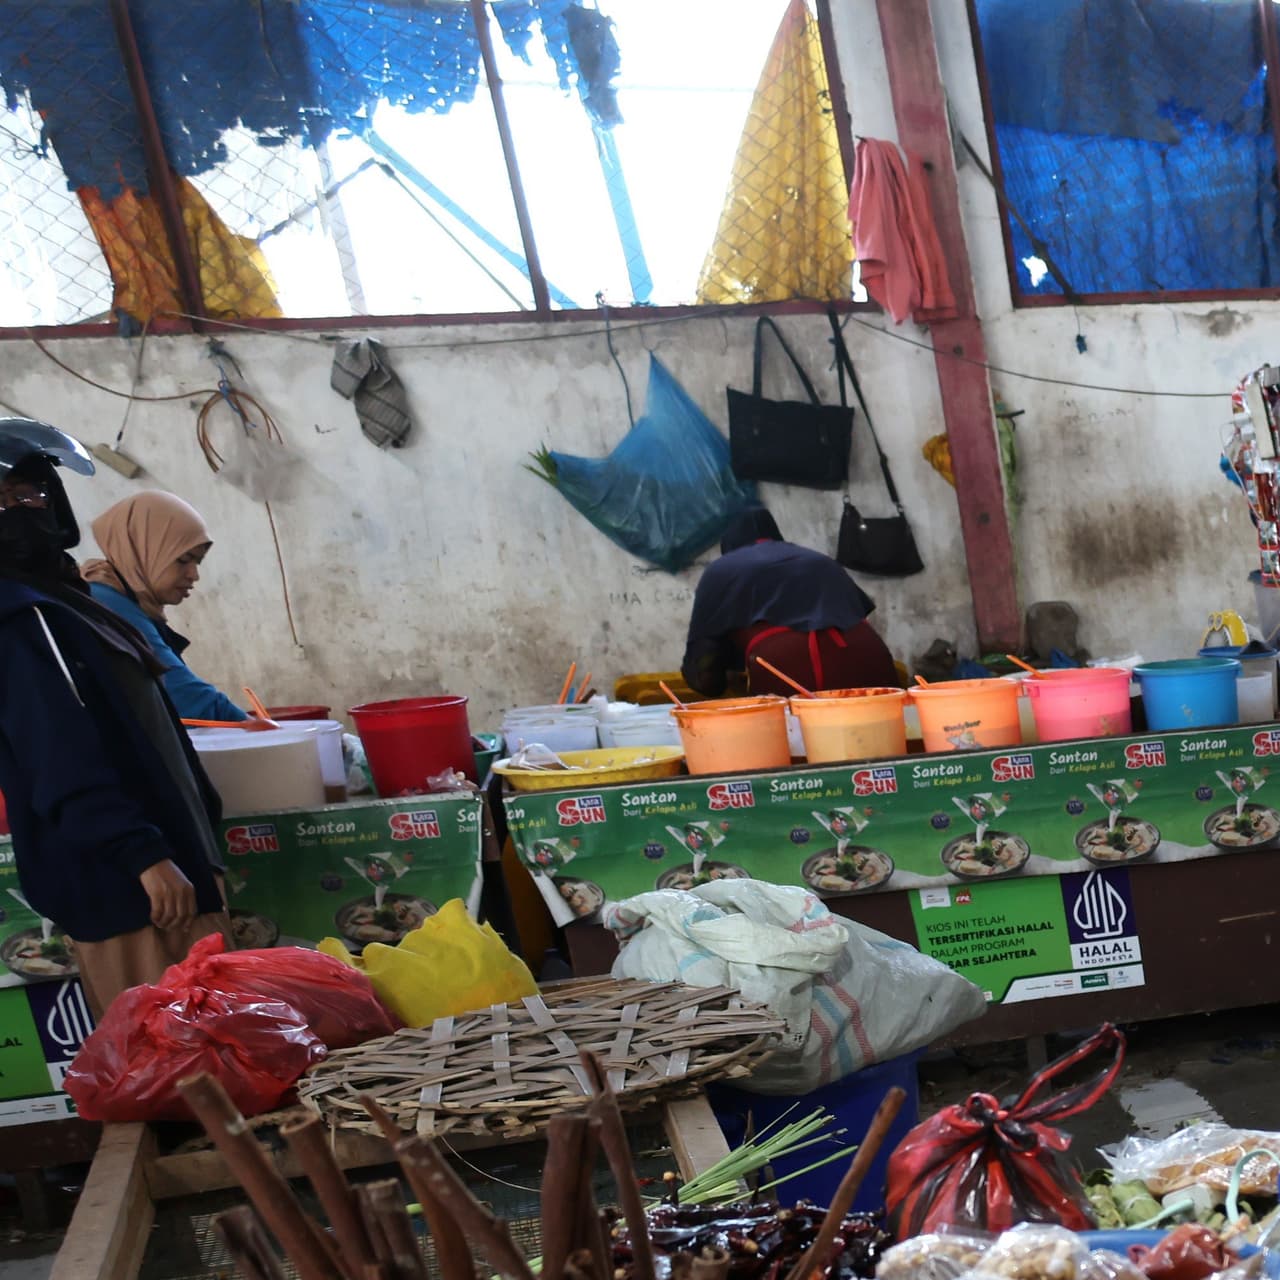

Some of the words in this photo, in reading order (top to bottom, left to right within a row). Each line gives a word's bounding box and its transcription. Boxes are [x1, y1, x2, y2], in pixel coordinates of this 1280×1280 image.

[1179, 738, 1227, 752] Santan
[1049, 750, 1098, 765] Santan
[1124, 744, 1166, 769] SUN
[912, 764, 964, 779] Santan
[991, 757, 1035, 782] SUN
[1050, 766, 1066, 775] Dari
[1068, 764, 1097, 774] Kelapa
[1100, 760, 1115, 769] Asli
[769, 778, 823, 793] Santan
[852, 770, 898, 796] SUN
[913, 779, 930, 788] Dari
[933, 777, 962, 787] Kelapa
[965, 774, 982, 783] Asli
[621, 791, 677, 807] Santan
[707, 785, 755, 811] SUN
[556, 799, 606, 826] SUN
[296, 821, 355, 836] Santan
[389, 814, 441, 840] SUN
[225, 825, 280, 855] SUN
[926, 921, 951, 933] KIOS
[954, 919, 969, 930] INI
[972, 915, 1006, 927] TELAH
[928, 926, 1015, 946] TERSERTIFIKASI
[1017, 921, 1054, 933] HALAL
[931, 945, 968, 959] DALAM
[971, 938, 1025, 954] PROGRAM
[1079, 941, 1132, 958] HALAL
[945, 958, 970, 969] SAR
[973, 949, 1037, 965] SEJAHTERA
[1081, 953, 1134, 965] INDONESIA
